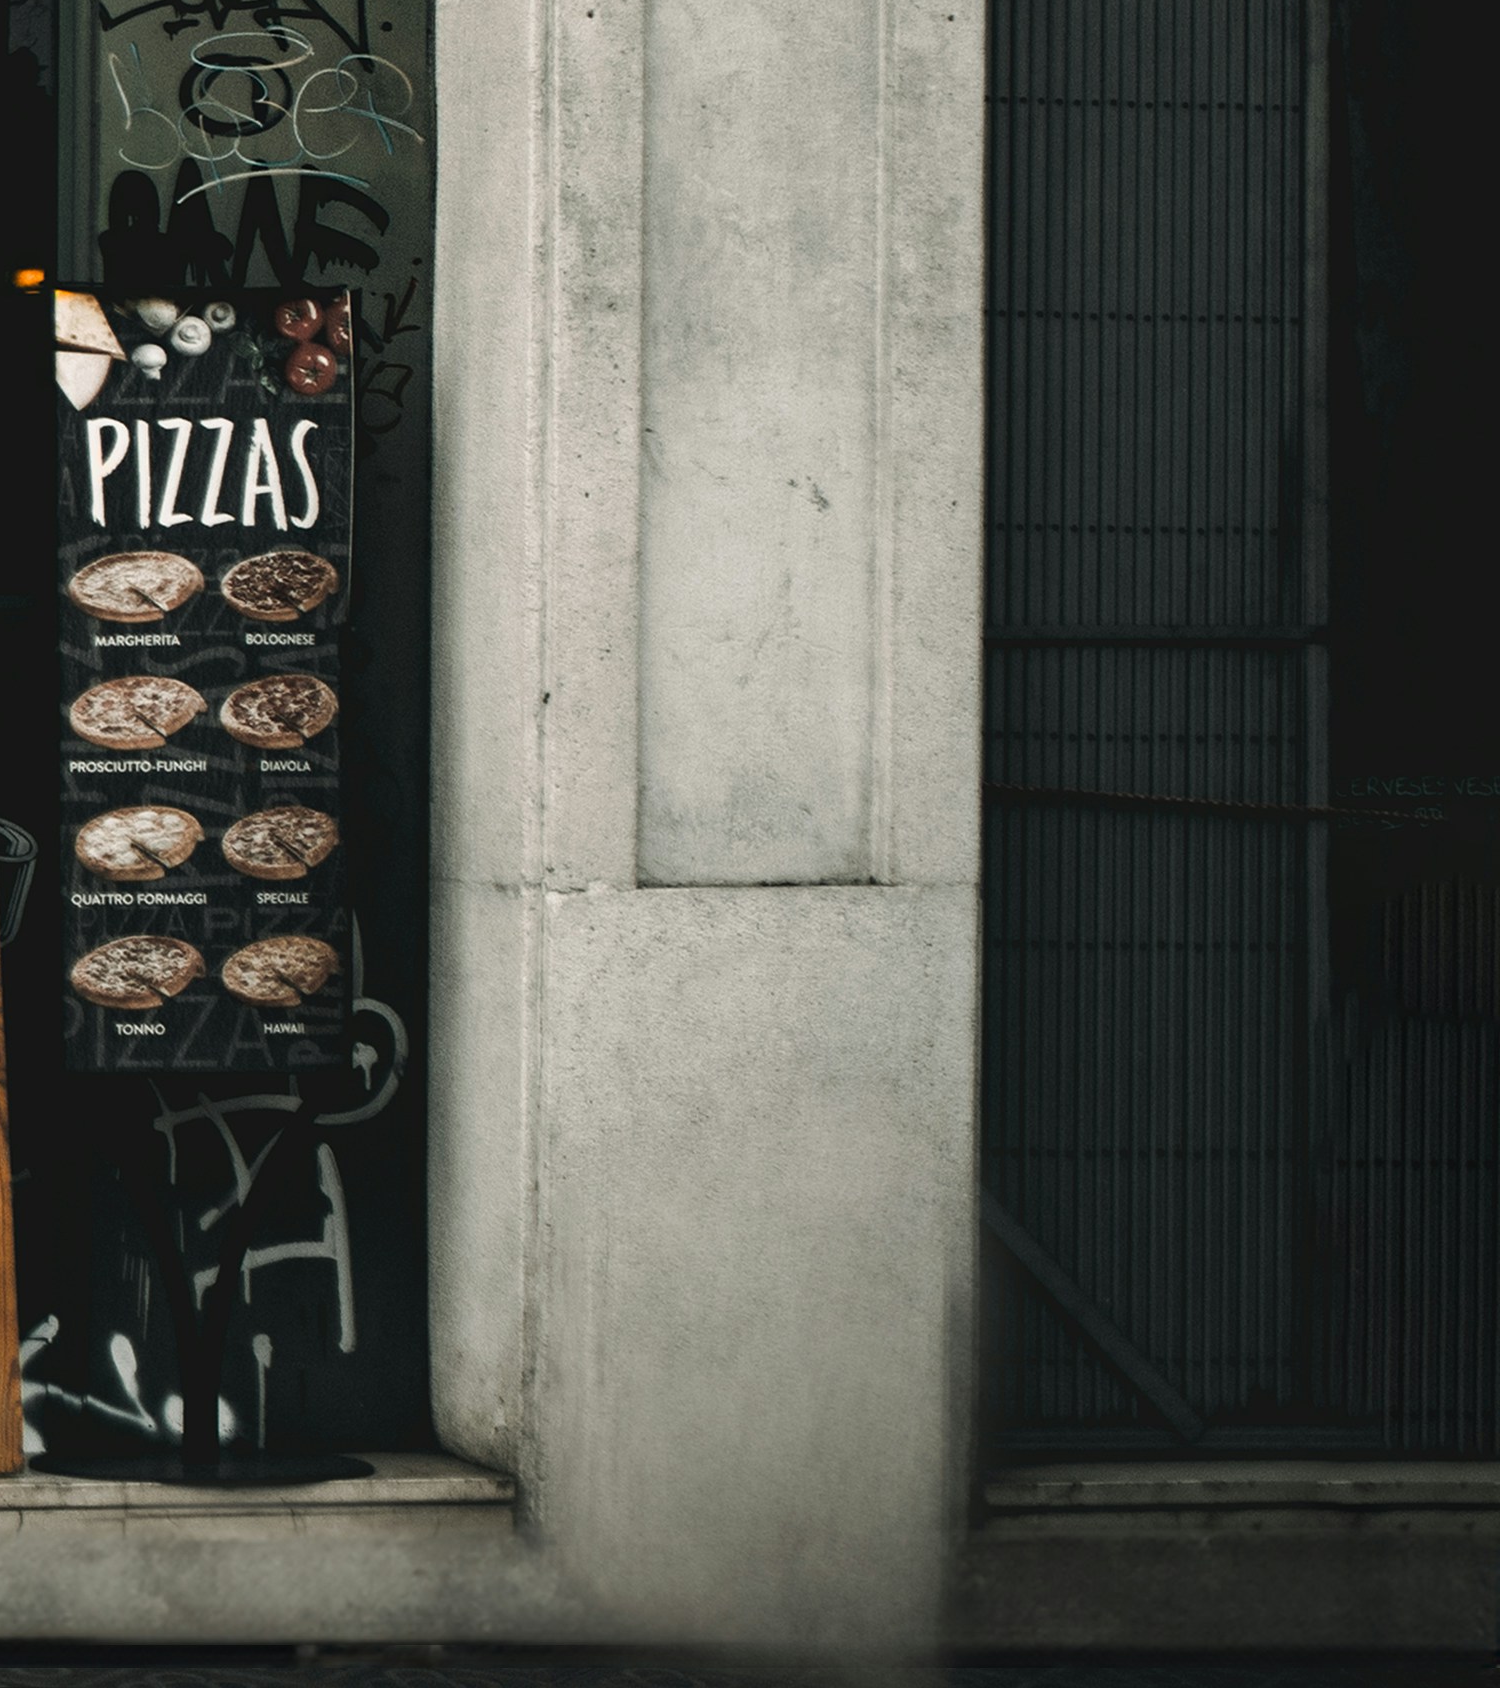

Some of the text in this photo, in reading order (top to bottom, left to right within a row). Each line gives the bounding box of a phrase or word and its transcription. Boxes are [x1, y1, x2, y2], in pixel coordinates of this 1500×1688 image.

[86, 417, 320, 531] PIZZAS
[94, 633, 316, 647] MARGHERITA BOLOGNESE
[69, 759, 311, 774] PROSCIUTTO-FUNGHI DIAVOLA
[70, 892, 309, 908] QUATTRO FORMAGGI SPECIALE
[115, 1023, 166, 1036] TONNO
